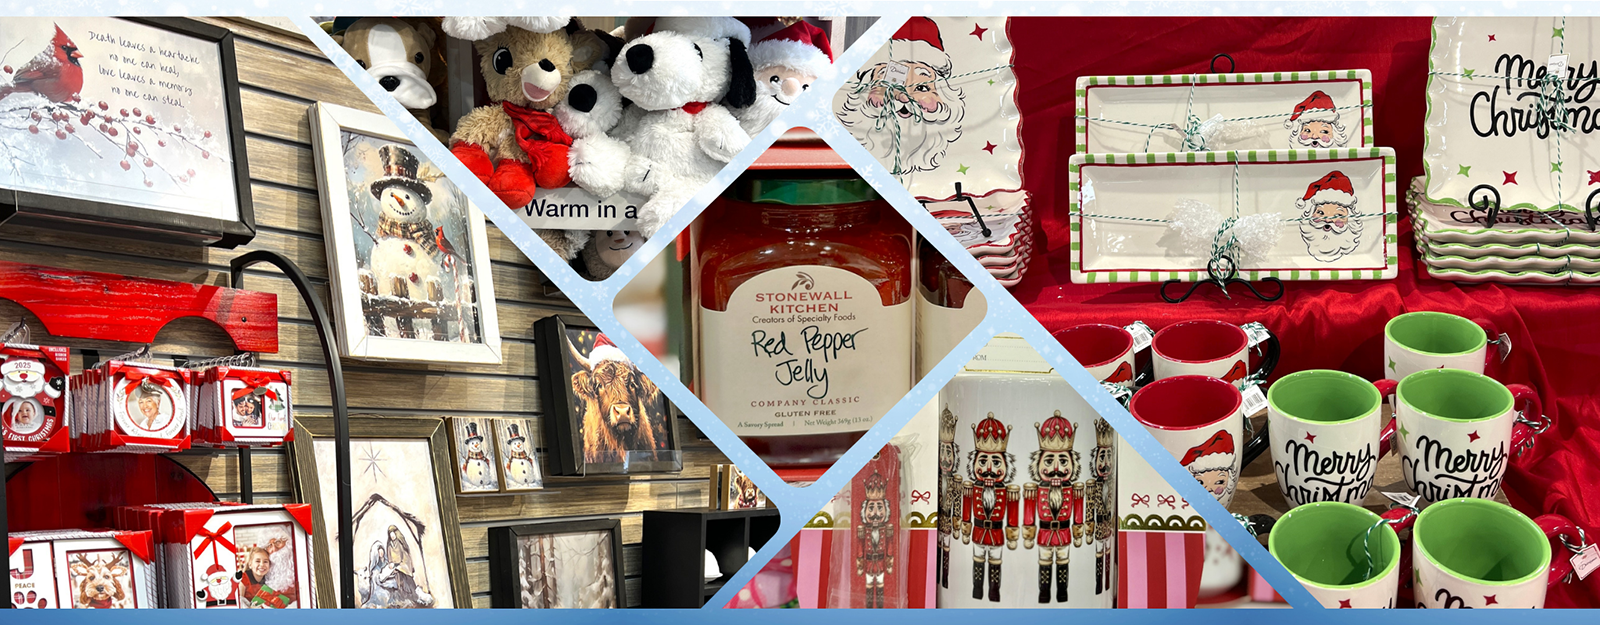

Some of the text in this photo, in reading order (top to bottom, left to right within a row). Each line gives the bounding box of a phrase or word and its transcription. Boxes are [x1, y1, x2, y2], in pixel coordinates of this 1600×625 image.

[88, 30, 200, 65] Death leaves a heartache
[109, 53, 180, 78] no one can heal,
[98, 64, 193, 97] love leaves a memory
[1495, 53, 1600, 103] Mery
[111, 86, 185, 109] no one can steal.
[525, 198, 639, 220] Warm in a
[755, 291, 853, 302] STONEWALL
[752, 312, 856, 325] Creators of Specialty Foods
[769, 303, 839, 314] KITCHEN
[751, 325, 869, 363] Red Pepper
[14, 361, 31, 369] 2025
[775, 358, 829, 399] Jelly
[750, 395, 861, 408] COMPANY CLASSIC
[774, 410, 811, 418] GLUTEN
[804, 415, 873, 427] Net Weight 369g (13 oz.)
[744, 421, 763, 430] Savory
[763, 421, 784, 429] Spread
[1285, 439, 1376, 482] Merry
[1415, 435, 1508, 480] Merry
